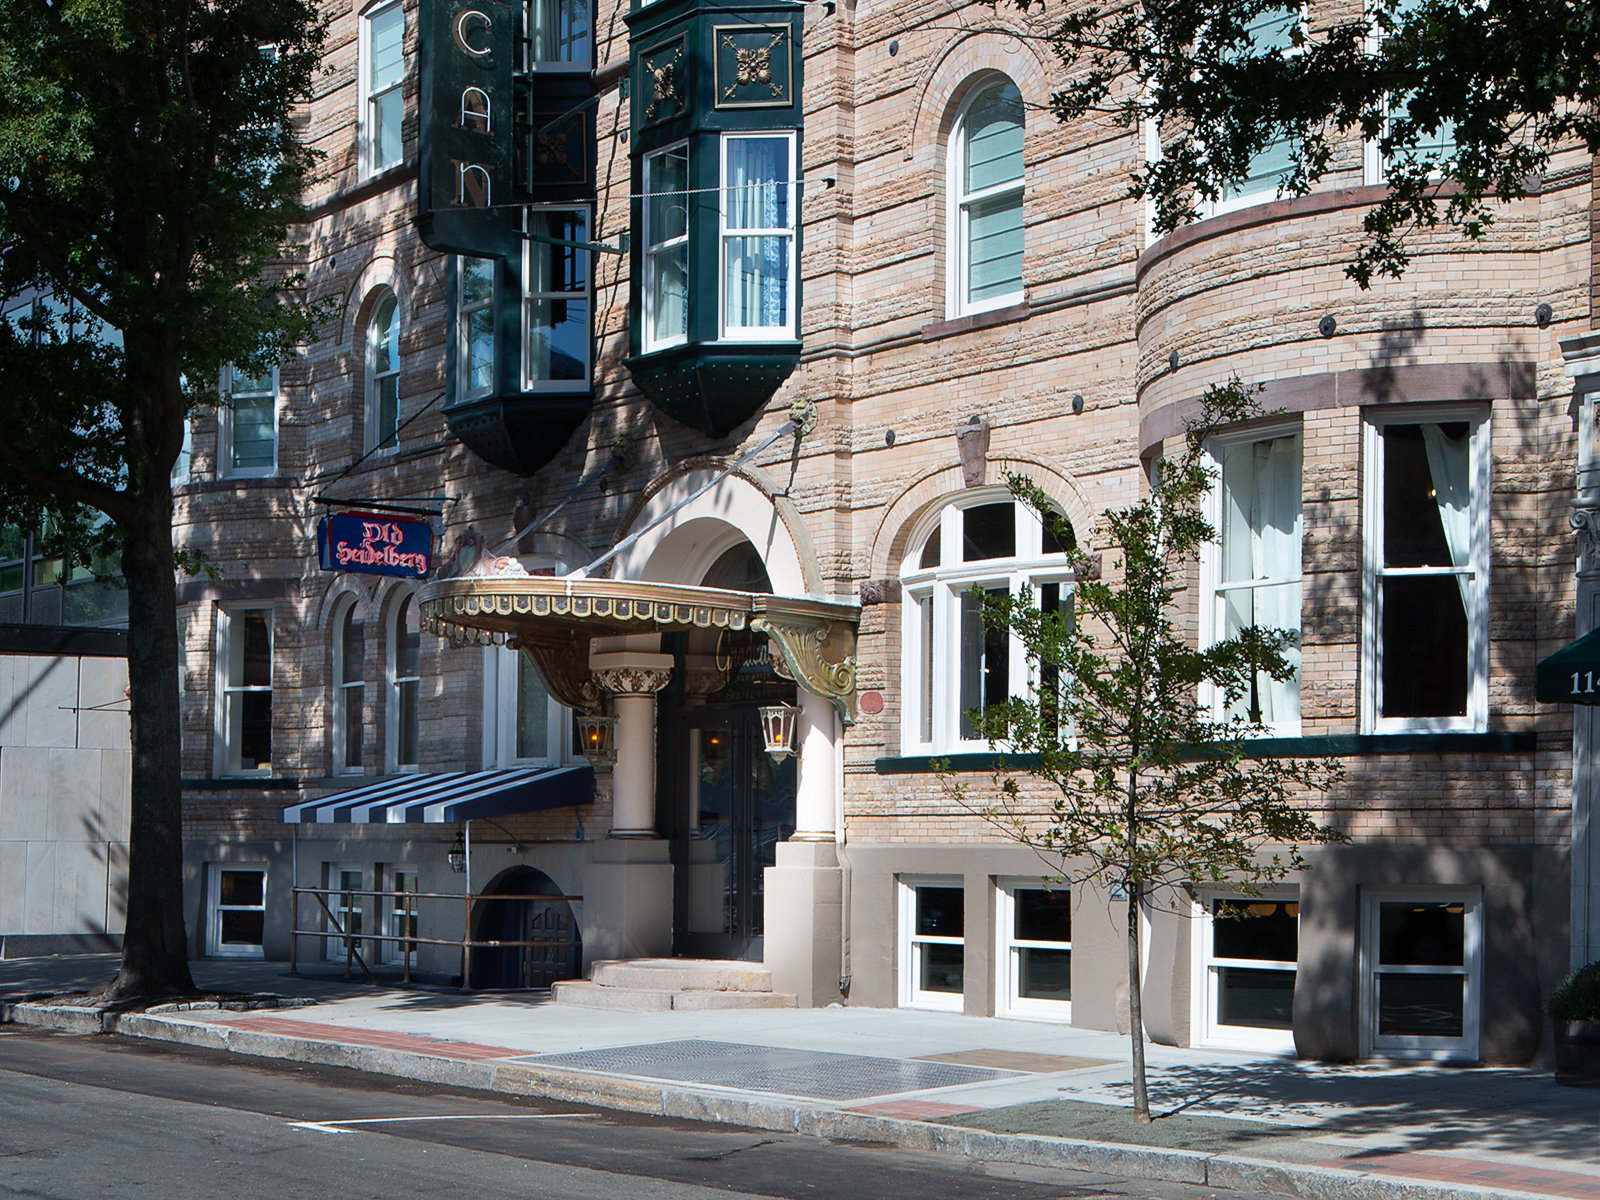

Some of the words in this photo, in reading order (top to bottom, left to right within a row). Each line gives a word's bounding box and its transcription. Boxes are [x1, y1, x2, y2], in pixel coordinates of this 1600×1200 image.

[363, 522, 404, 545] Old
[336, 541, 428, 573] Heidelberg
[1571, 672, 1600, 694] 11
